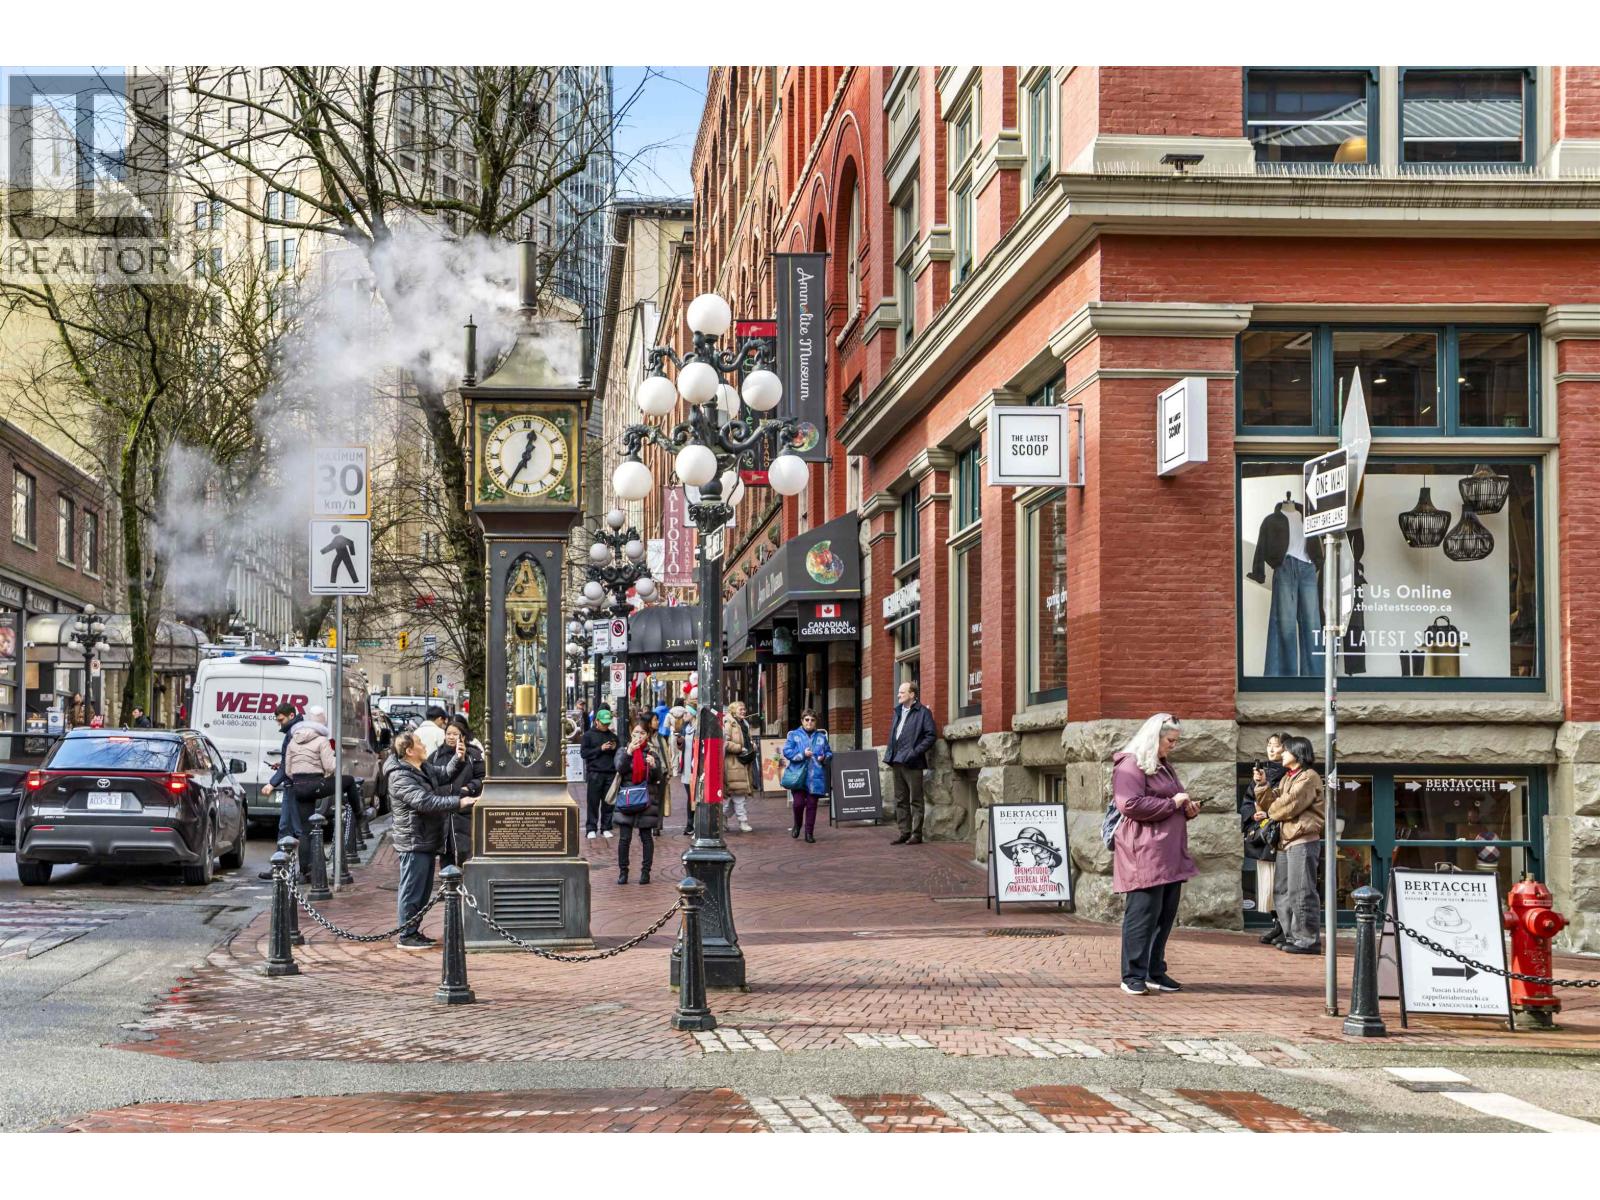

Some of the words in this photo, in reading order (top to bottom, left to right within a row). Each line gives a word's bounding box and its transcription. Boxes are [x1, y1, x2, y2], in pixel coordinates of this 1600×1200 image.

[800, 338, 812, 401] Museum
[1011, 434, 1023, 442] THE
[1026, 434, 1049, 442] LATEST
[1011, 444, 1049, 456] SCOOP
[317, 464, 364, 497] 30
[1315, 474, 1328, 496] ONE
[1330, 468, 1345, 491] WAY
[324, 499, 356, 511] km/h
[668, 489, 679, 513] AL
[667, 516, 680, 576] PORTO
[1370, 585, 1391, 599] Us
[1397, 584, 1452, 599] Online
[801, 627, 823, 635] GEMS
[830, 626, 856, 635] ROCKS
[808, 621, 849, 629] CANADIAN
[666, 639, 680, 649] 321
[1350, 630, 1406, 647] LATEST
[1414, 630, 1469, 647] SCOOP
[221, 713, 260, 721] MECHANICAL
[1426, 779, 1496, 788] BERTACCHI
[1000, 810, 1058, 818] BERTACCHI
[1039, 875, 1050, 884] HAT
[1008, 884, 1031, 893] MAKING
[1038, 884, 1058, 892] ACTION
[1404, 880, 1487, 892] BERTACCHI
